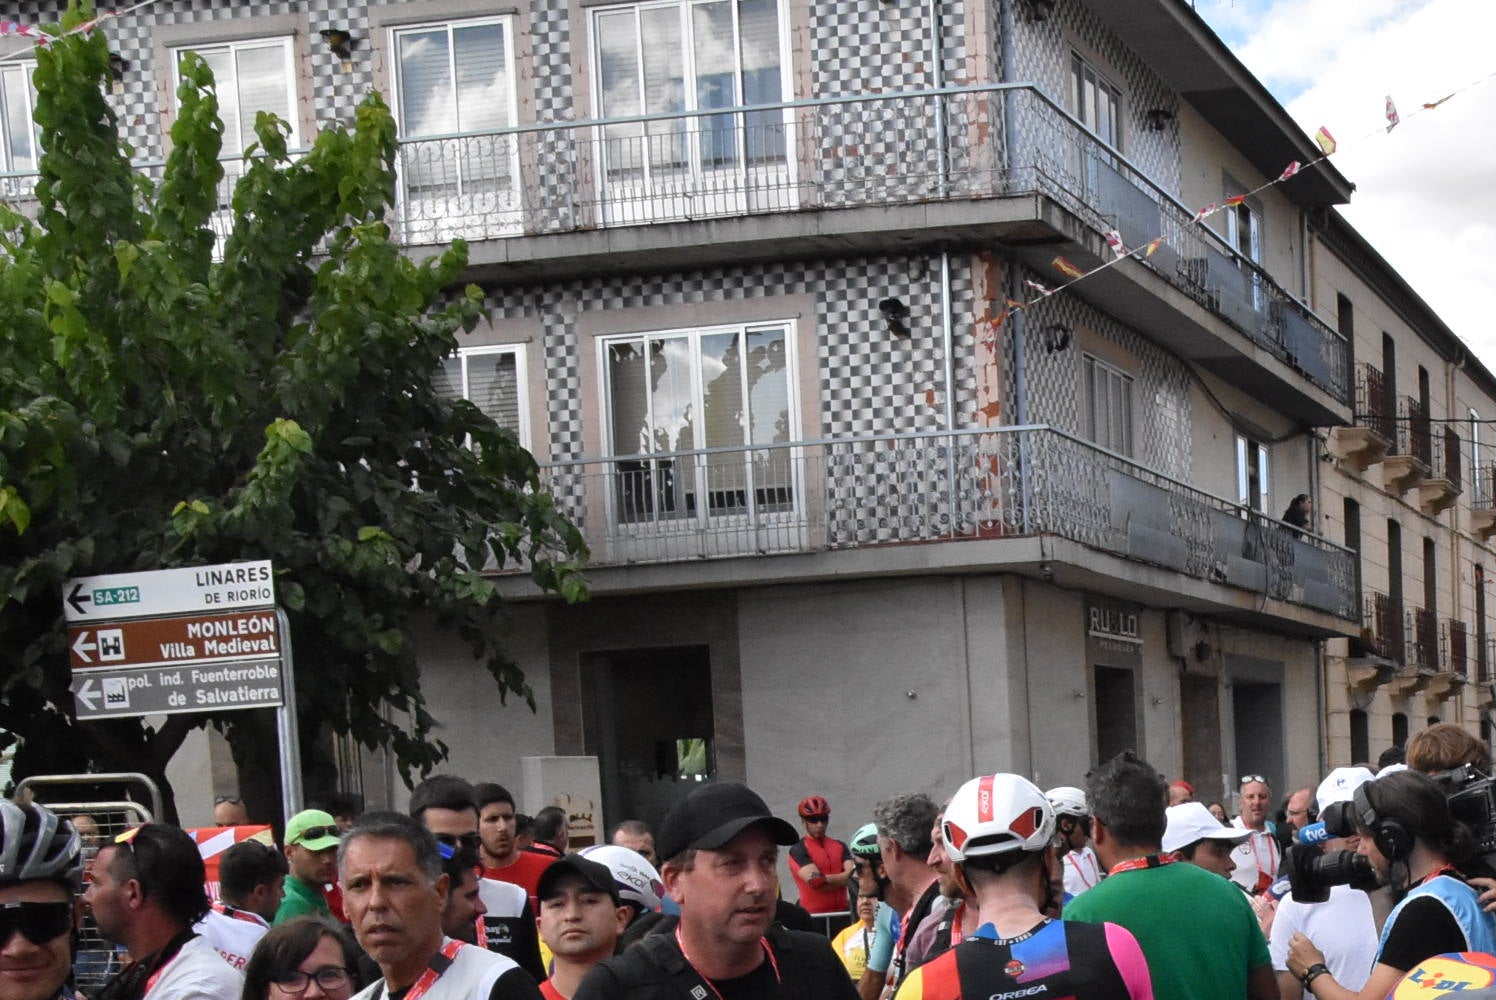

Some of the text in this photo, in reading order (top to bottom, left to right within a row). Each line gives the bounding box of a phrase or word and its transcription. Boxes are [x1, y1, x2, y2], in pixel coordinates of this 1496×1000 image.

[195, 566, 270, 587] LINARES
[94, 587, 140, 604] SA-212
[205, 588, 271, 604] DE RIORÍO
[187, 615, 275, 639] MONLEÓN
[159, 636, 276, 659] Villa Medieval
[160, 672, 184, 686] ind.
[192, 665, 278, 683] Fuenterroble
[168, 686, 279, 706] de Salvatierra
[1305, 829, 1329, 842] tve
